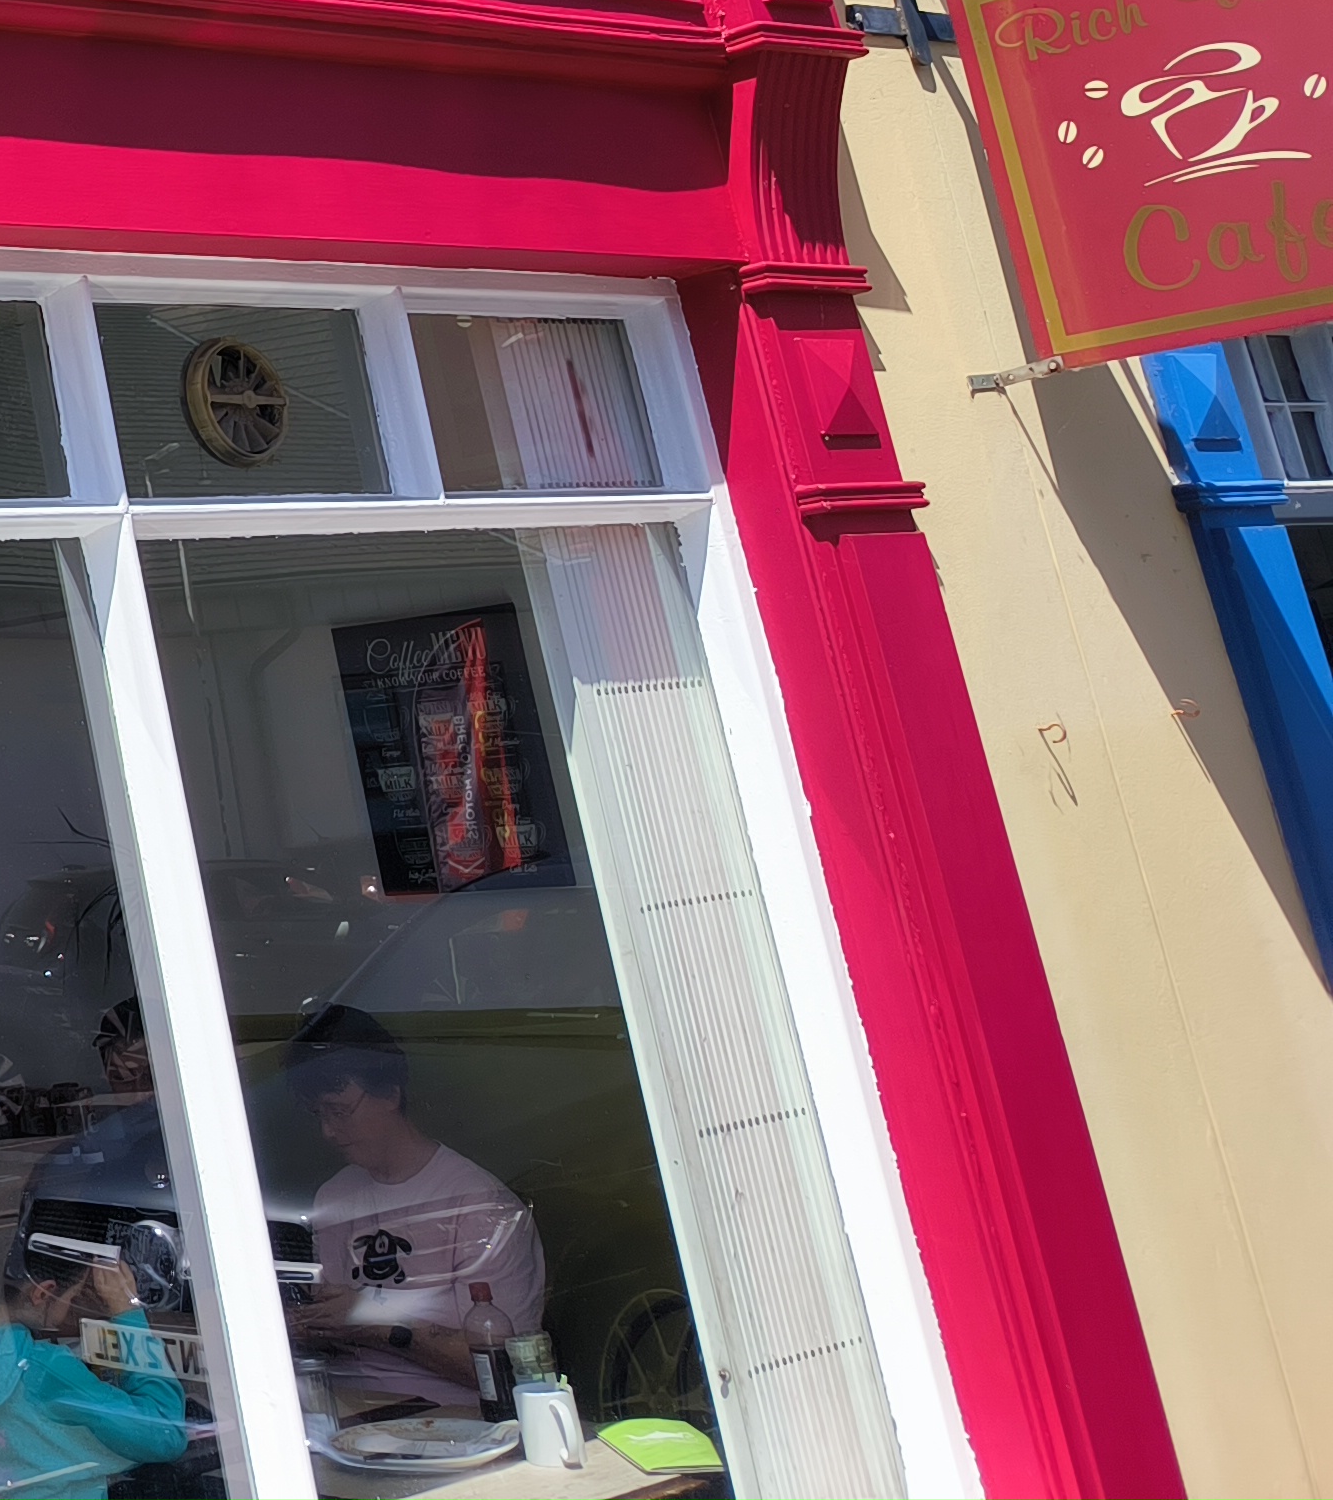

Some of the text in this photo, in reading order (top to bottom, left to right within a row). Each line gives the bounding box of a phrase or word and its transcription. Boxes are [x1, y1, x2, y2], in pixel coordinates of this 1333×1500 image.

[366, 638, 431, 682] Coffee
[412, 672, 440, 684] YOUR
[442, 666, 486, 680] COFFEE
[384, 777, 413, 790] MILK
